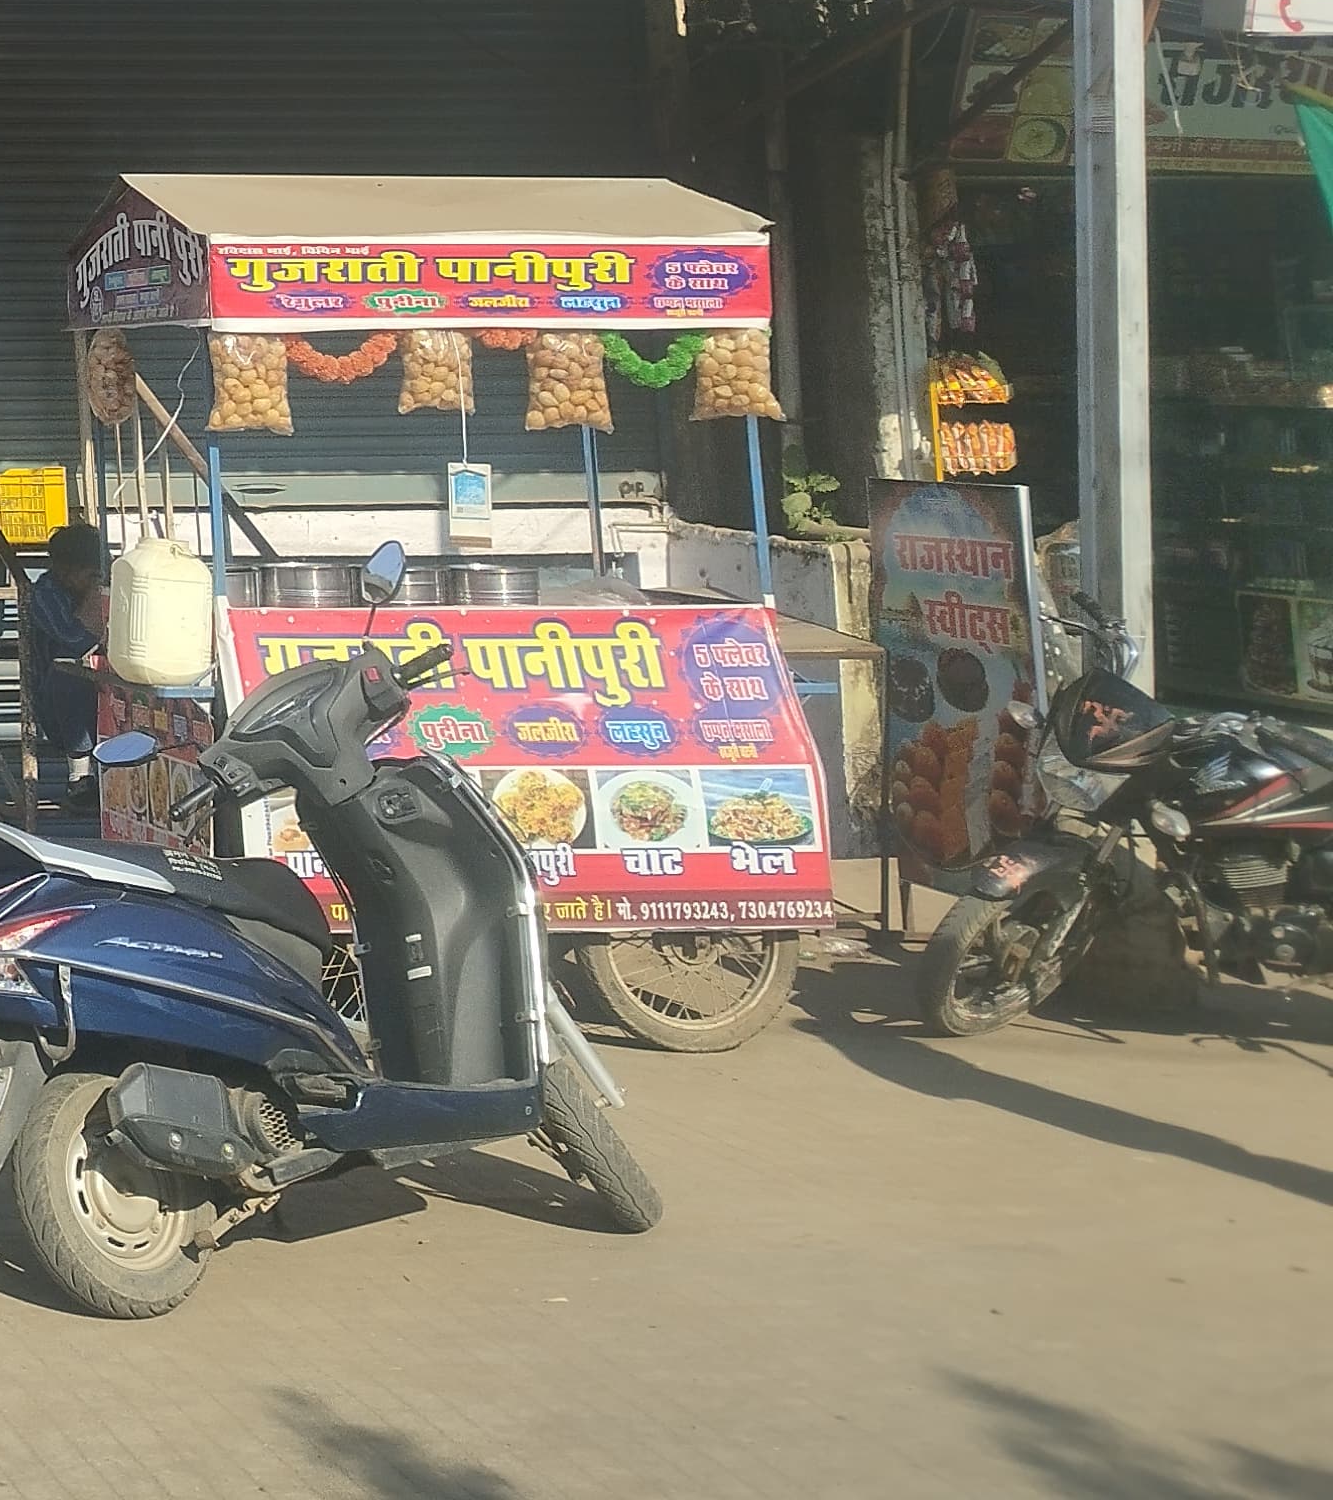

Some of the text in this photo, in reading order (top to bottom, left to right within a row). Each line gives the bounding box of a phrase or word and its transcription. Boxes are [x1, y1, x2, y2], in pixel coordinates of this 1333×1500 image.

[227, 251, 636, 292] गुजराती पानीपुरी
[665, 262, 680, 275] 5
[893, 532, 1014, 582] राजस्थान
[923, 590, 1011, 654] स्वीट्स
[462, 621, 666, 707] पानीपुरी
[693, 644, 711, 668] 5
[700, 671, 769, 701] के साथ
[419, 716, 490, 750] पुदीना
[605, 720, 672, 750] लहसुन
[620, 846, 685, 876] चाट
[729, 841, 798, 876] भेल
[555, 896, 589, 919] जाते
[738, 899, 834, 920] 7304769234
